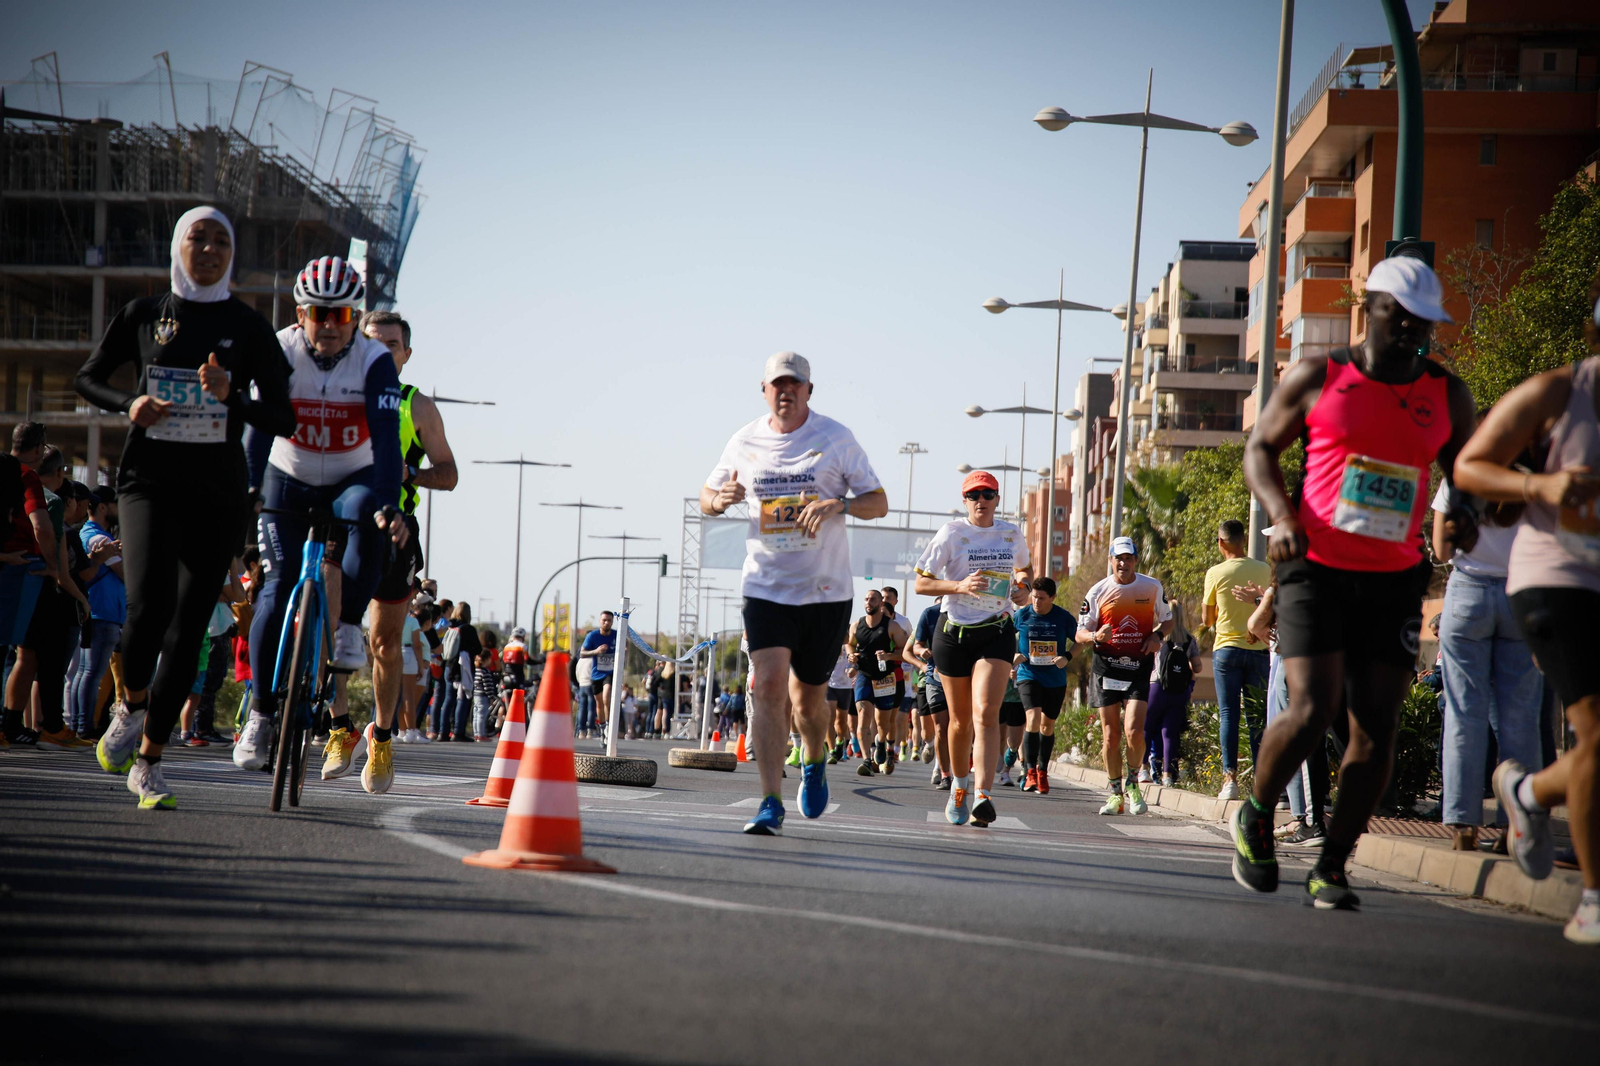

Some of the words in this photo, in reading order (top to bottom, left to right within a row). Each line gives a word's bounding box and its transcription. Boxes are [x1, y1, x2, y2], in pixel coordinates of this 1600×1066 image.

[789, 473, 815, 483] 2024
[1353, 472, 1412, 502] 1458
[1032, 645, 1054, 653] 1520
